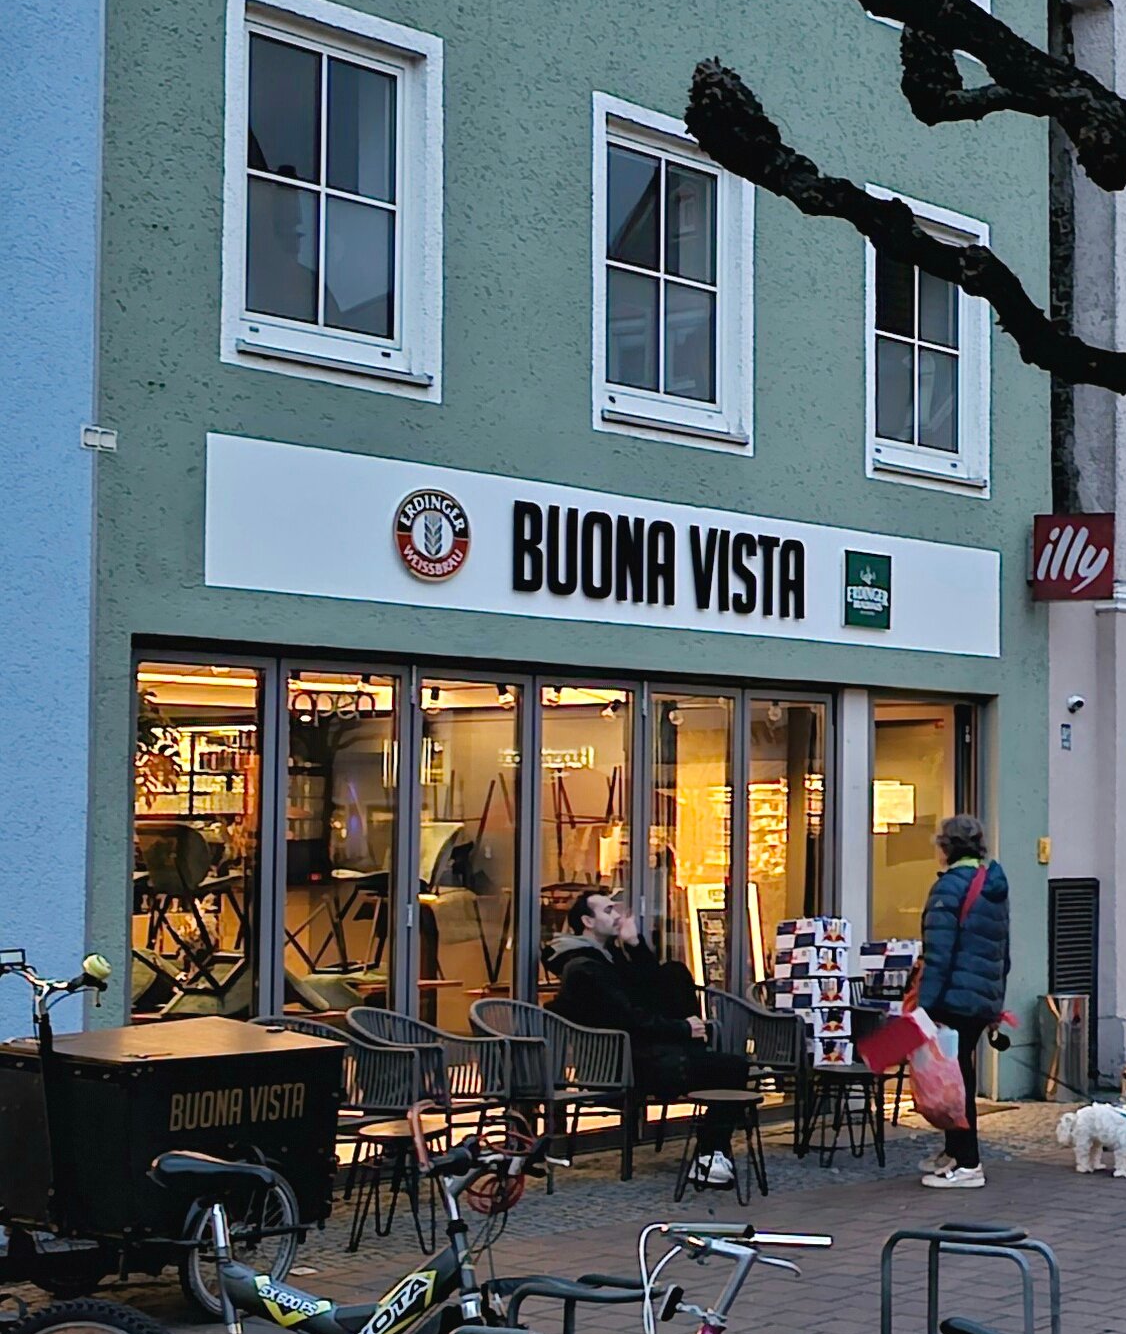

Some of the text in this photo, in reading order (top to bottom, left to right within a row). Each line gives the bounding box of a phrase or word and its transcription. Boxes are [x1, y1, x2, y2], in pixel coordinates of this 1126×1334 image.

[400, 494, 466, 532] ERDINGER
[512, 499, 805, 621] BUONA VISTA
[1037, 525, 1110, 594] illy
[169, 1082, 305, 1132] BUONA VISTA
